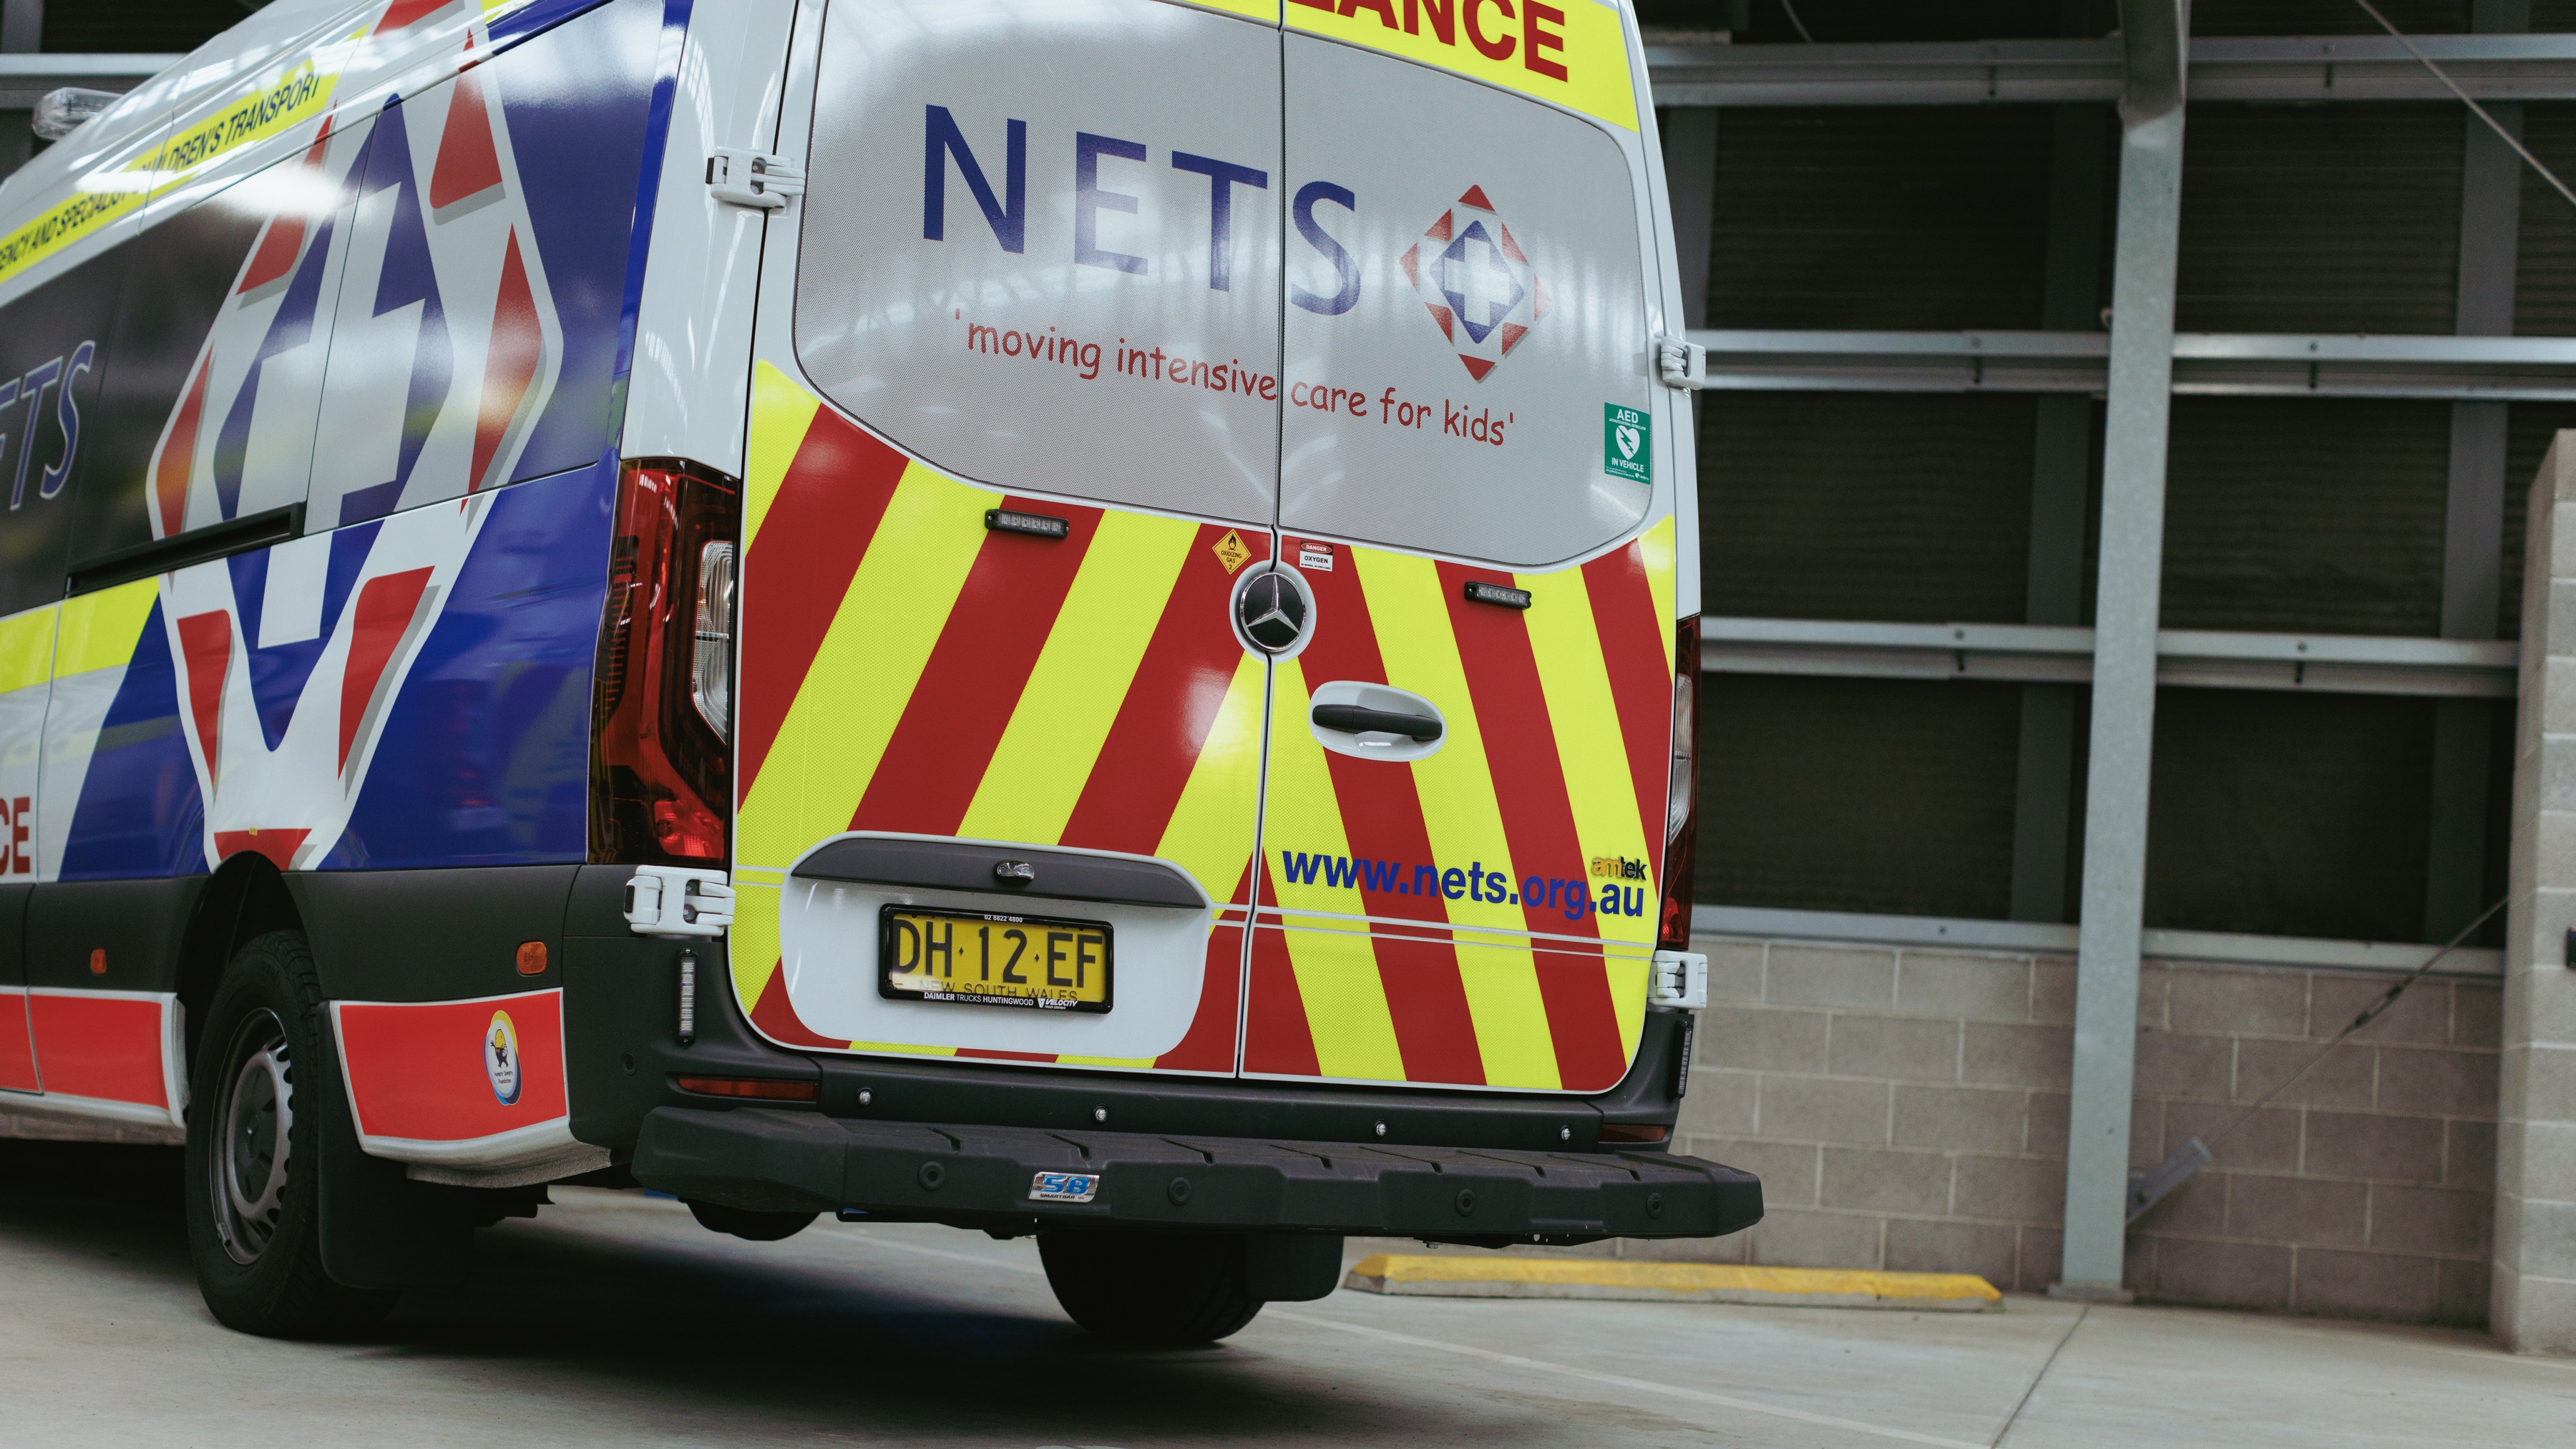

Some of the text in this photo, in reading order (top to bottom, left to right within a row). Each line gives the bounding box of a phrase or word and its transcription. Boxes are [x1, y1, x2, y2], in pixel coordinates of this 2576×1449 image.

[1288, 0, 1567, 82] NCE
[923, 104, 1360, 316] NETS
[1117, 338, 1277, 401] intensive
[1291, 381, 1367, 416] care
[1380, 387, 1431, 429] for
[1444, 399, 1513, 446] kids'
[1617, 409, 1639, 424] AED
[1611, 457, 1619, 467] IN
[1619, 459, 1644, 473] VEHICLE
[1221, 550, 1242, 559] OXIDIZING
[1306, 544, 1327, 552] DANGER
[1304, 555, 1329, 564] OXYGEN
[1591, 856, 1647, 881] amtek
[1282, 851, 1644, 921] www.nets.org.au
[894, 919, 1103, 988] DH 12 EF
[919, 980, 1078, 1000] NEW SOUTH WALES
[924, 992, 1034, 1006] DAIMLER TRUCKS HUNTINGWOOD
